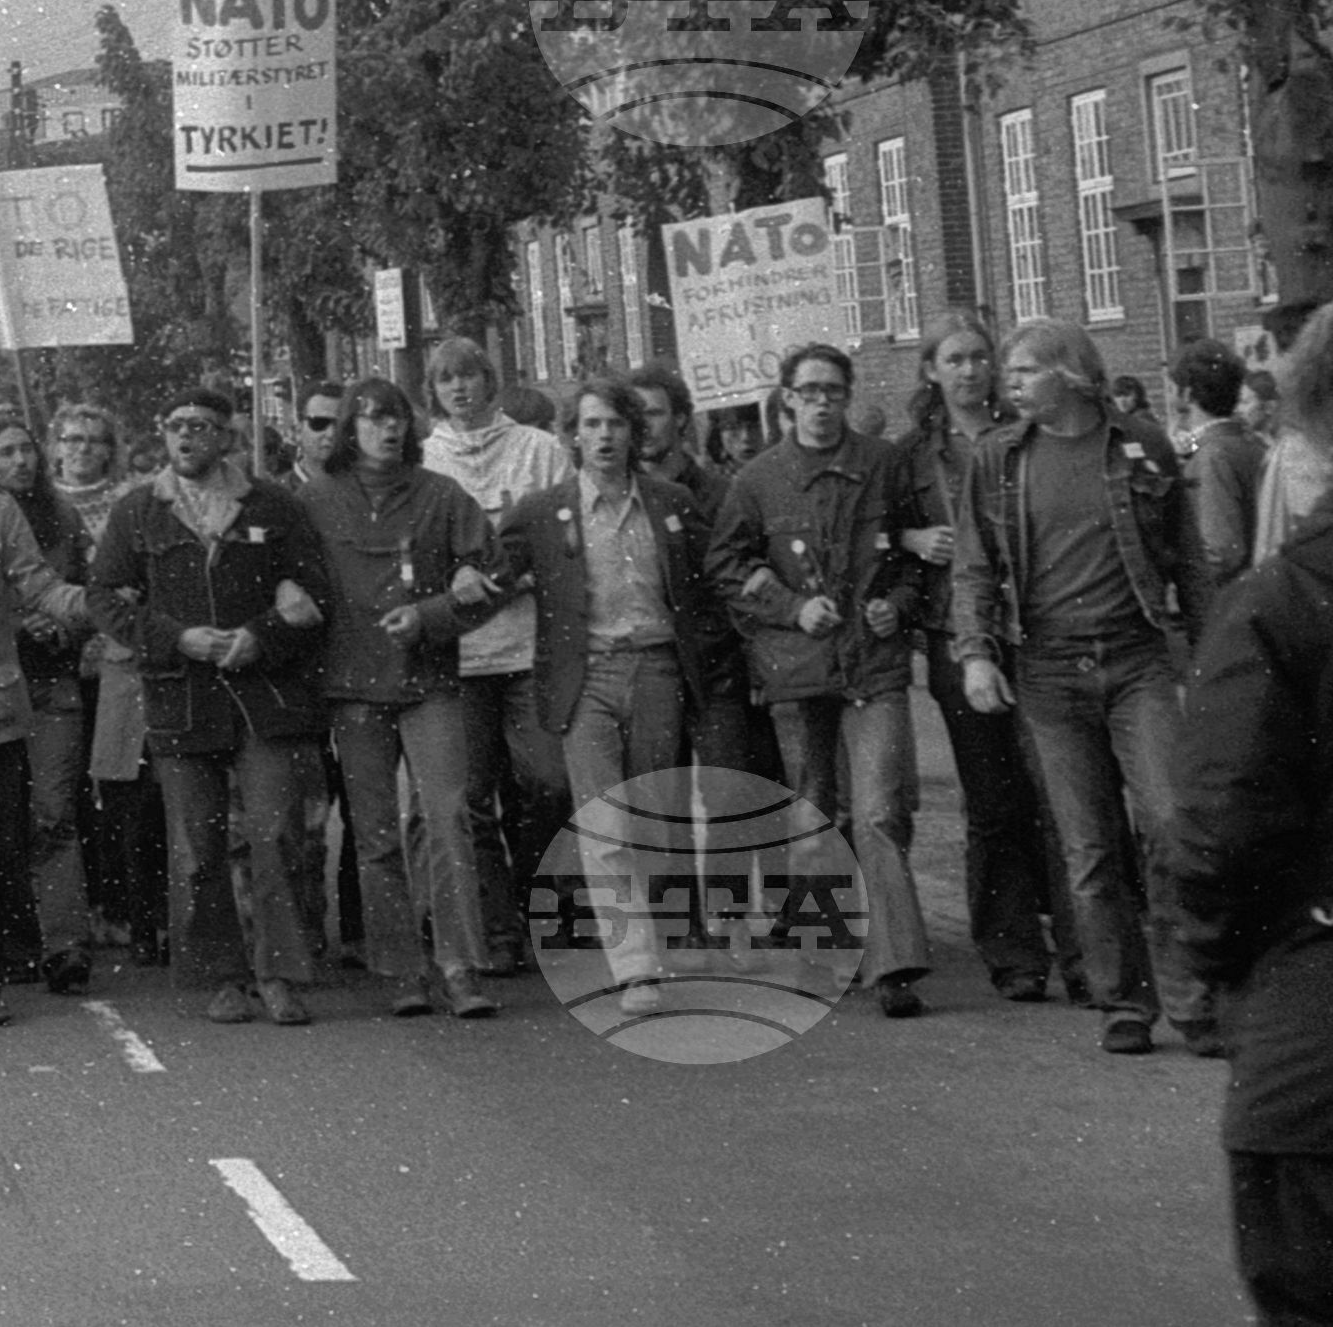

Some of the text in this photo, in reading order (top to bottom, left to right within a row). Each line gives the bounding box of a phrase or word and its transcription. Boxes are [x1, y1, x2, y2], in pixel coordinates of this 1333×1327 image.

[186, 34, 304, 59] STØTTER
[179, 118, 328, 154] TYRKIET!
[52, 237, 116, 261] RIGE
[672, 213, 830, 278] NATO
[693, 346, 801, 391] EURO
